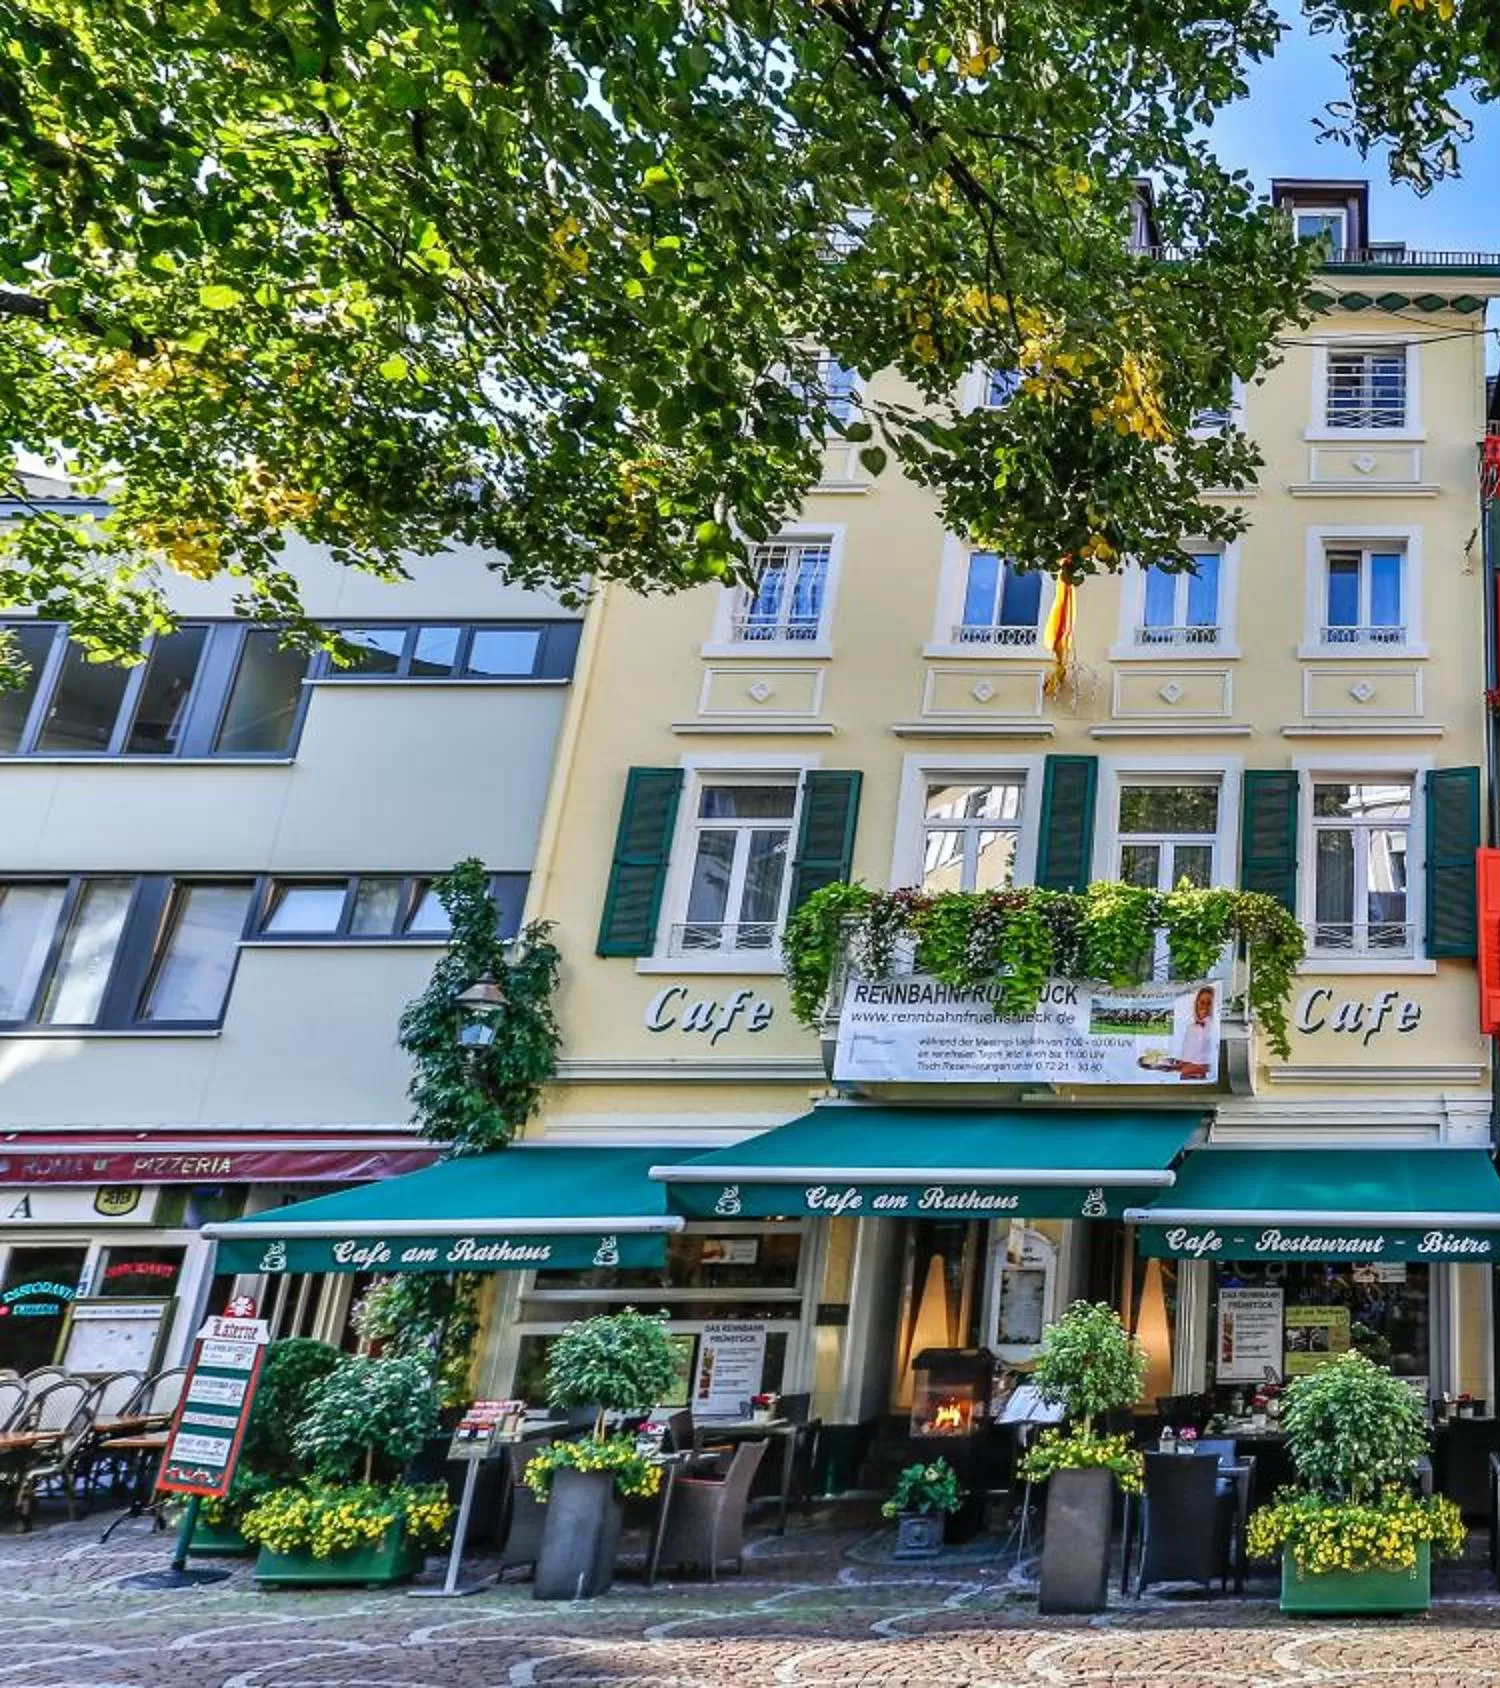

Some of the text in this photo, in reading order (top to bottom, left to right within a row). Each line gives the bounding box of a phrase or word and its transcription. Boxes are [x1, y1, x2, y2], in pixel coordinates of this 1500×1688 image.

[643, 984, 775, 1046] Cafe
[1294, 986, 1422, 1047] Cafe
[959, 1036, 974, 1047] der
[133, 1156, 233, 1174] PIZZERIA
[804, 1186, 1020, 1215] Cafe am Rathaus
[332, 1237, 553, 1271] Cafe am Rathaus
[1165, 1228, 1223, 1257] Cafe
[1255, 1229, 1385, 1253] Restaurant
[1417, 1229, 1491, 1253] Bistro
